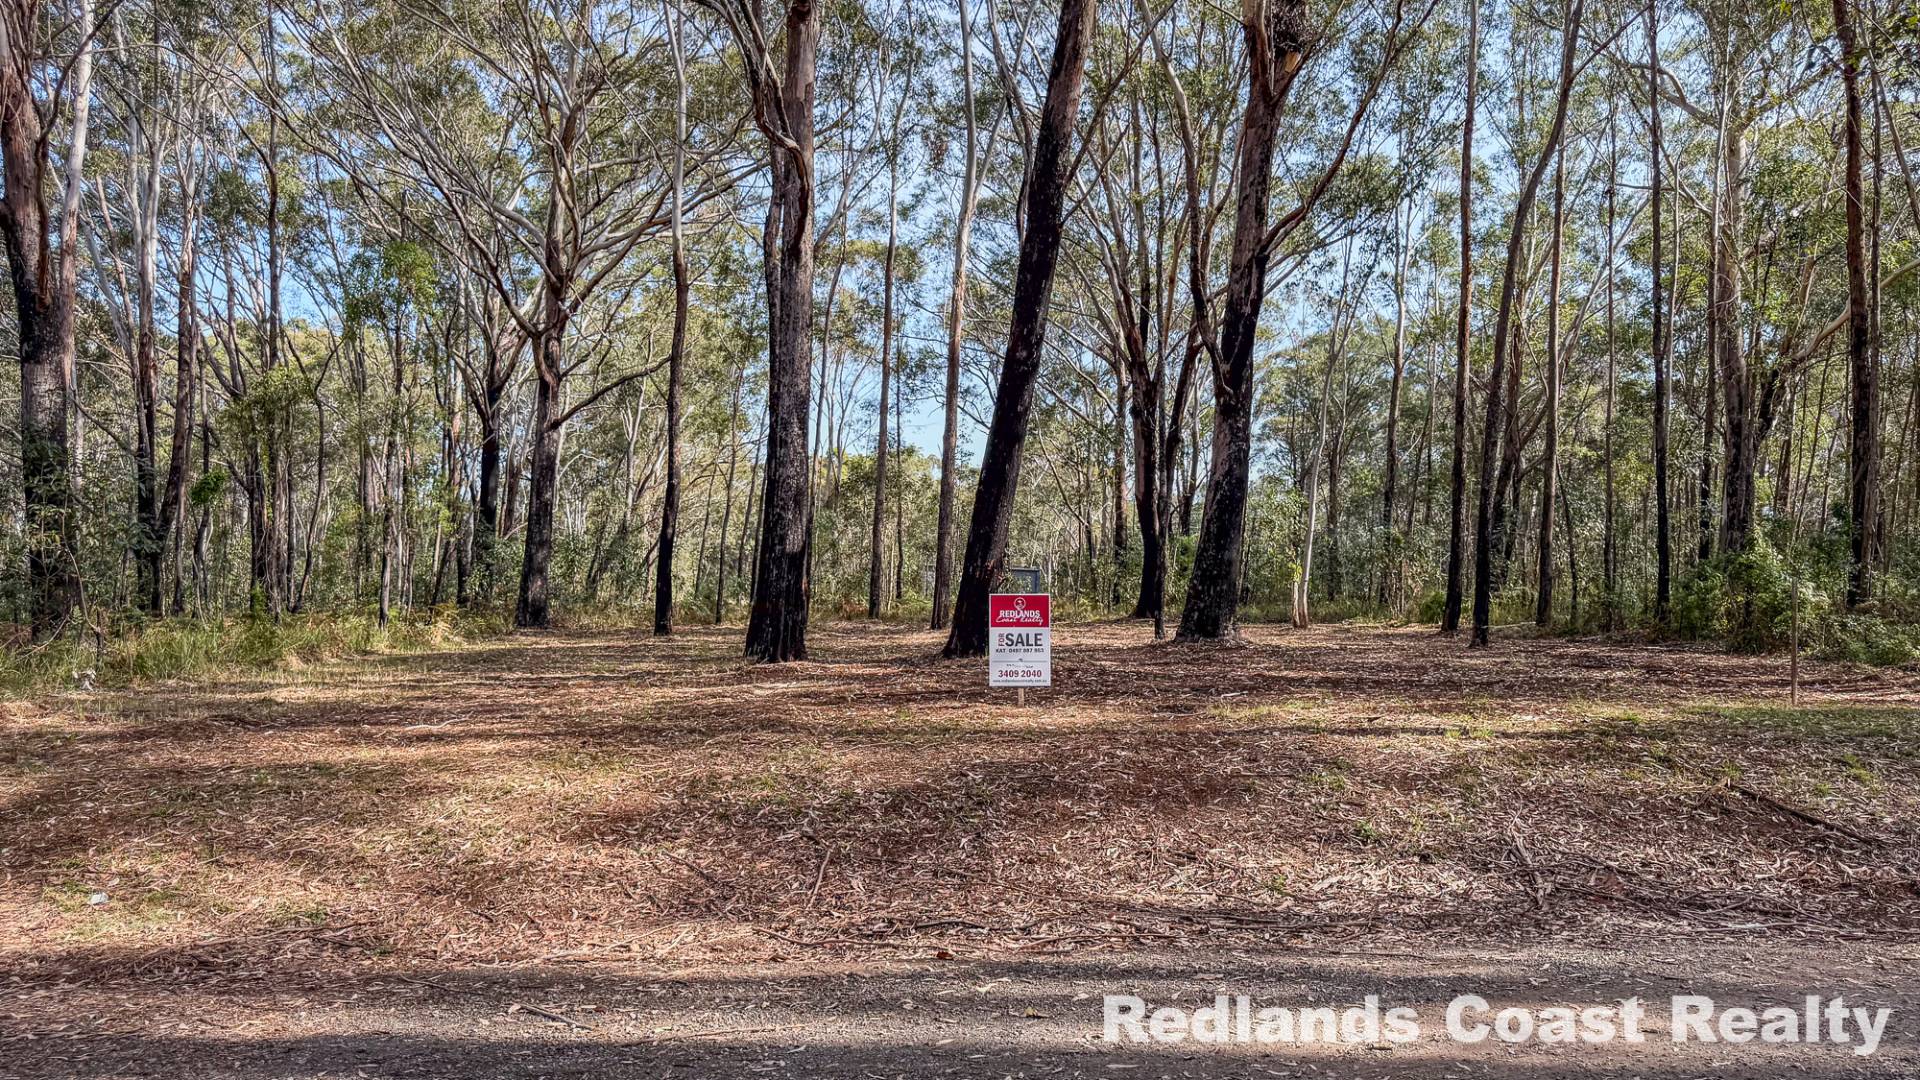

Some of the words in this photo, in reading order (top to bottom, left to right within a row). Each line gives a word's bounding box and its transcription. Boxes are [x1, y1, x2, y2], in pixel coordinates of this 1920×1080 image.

[1000, 610, 1040, 618] REDLANDS
[1005, 633, 1043, 647] SALE
[998, 669, 1019, 678] 3409
[1021, 669, 1042, 678] 2040
